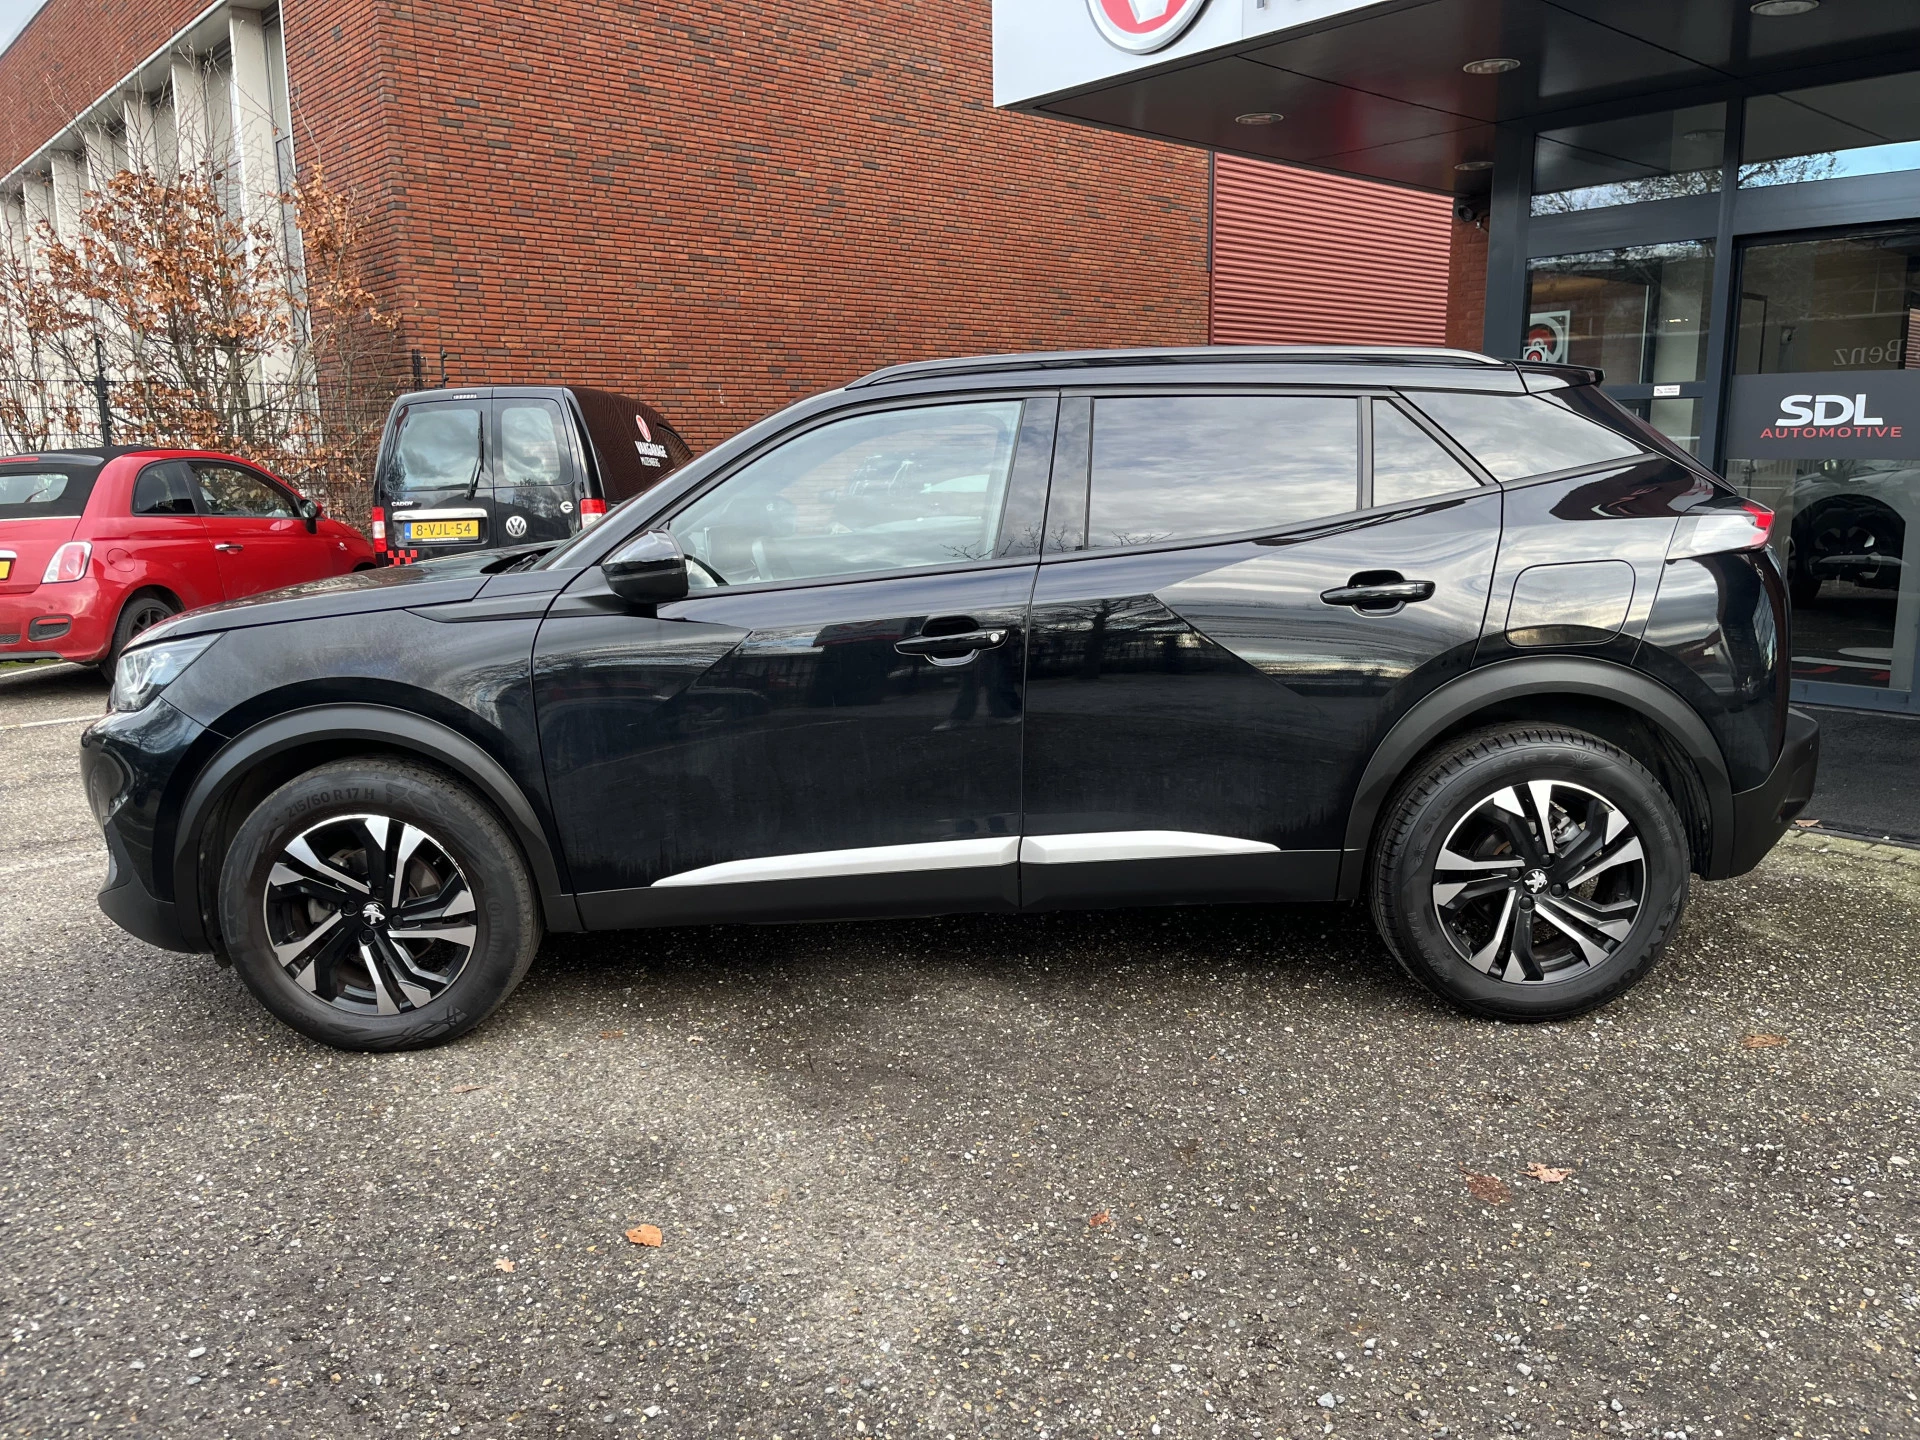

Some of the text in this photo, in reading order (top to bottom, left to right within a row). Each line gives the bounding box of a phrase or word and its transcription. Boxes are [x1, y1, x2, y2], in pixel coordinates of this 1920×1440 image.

[1774, 393, 1884, 427] SDL
[1760, 426, 1903, 439] AUTOMOTIVE
[416, 523, 472, 537] 8-VJL-54
[285, 787, 375, 818] 215/60 R 17 H
